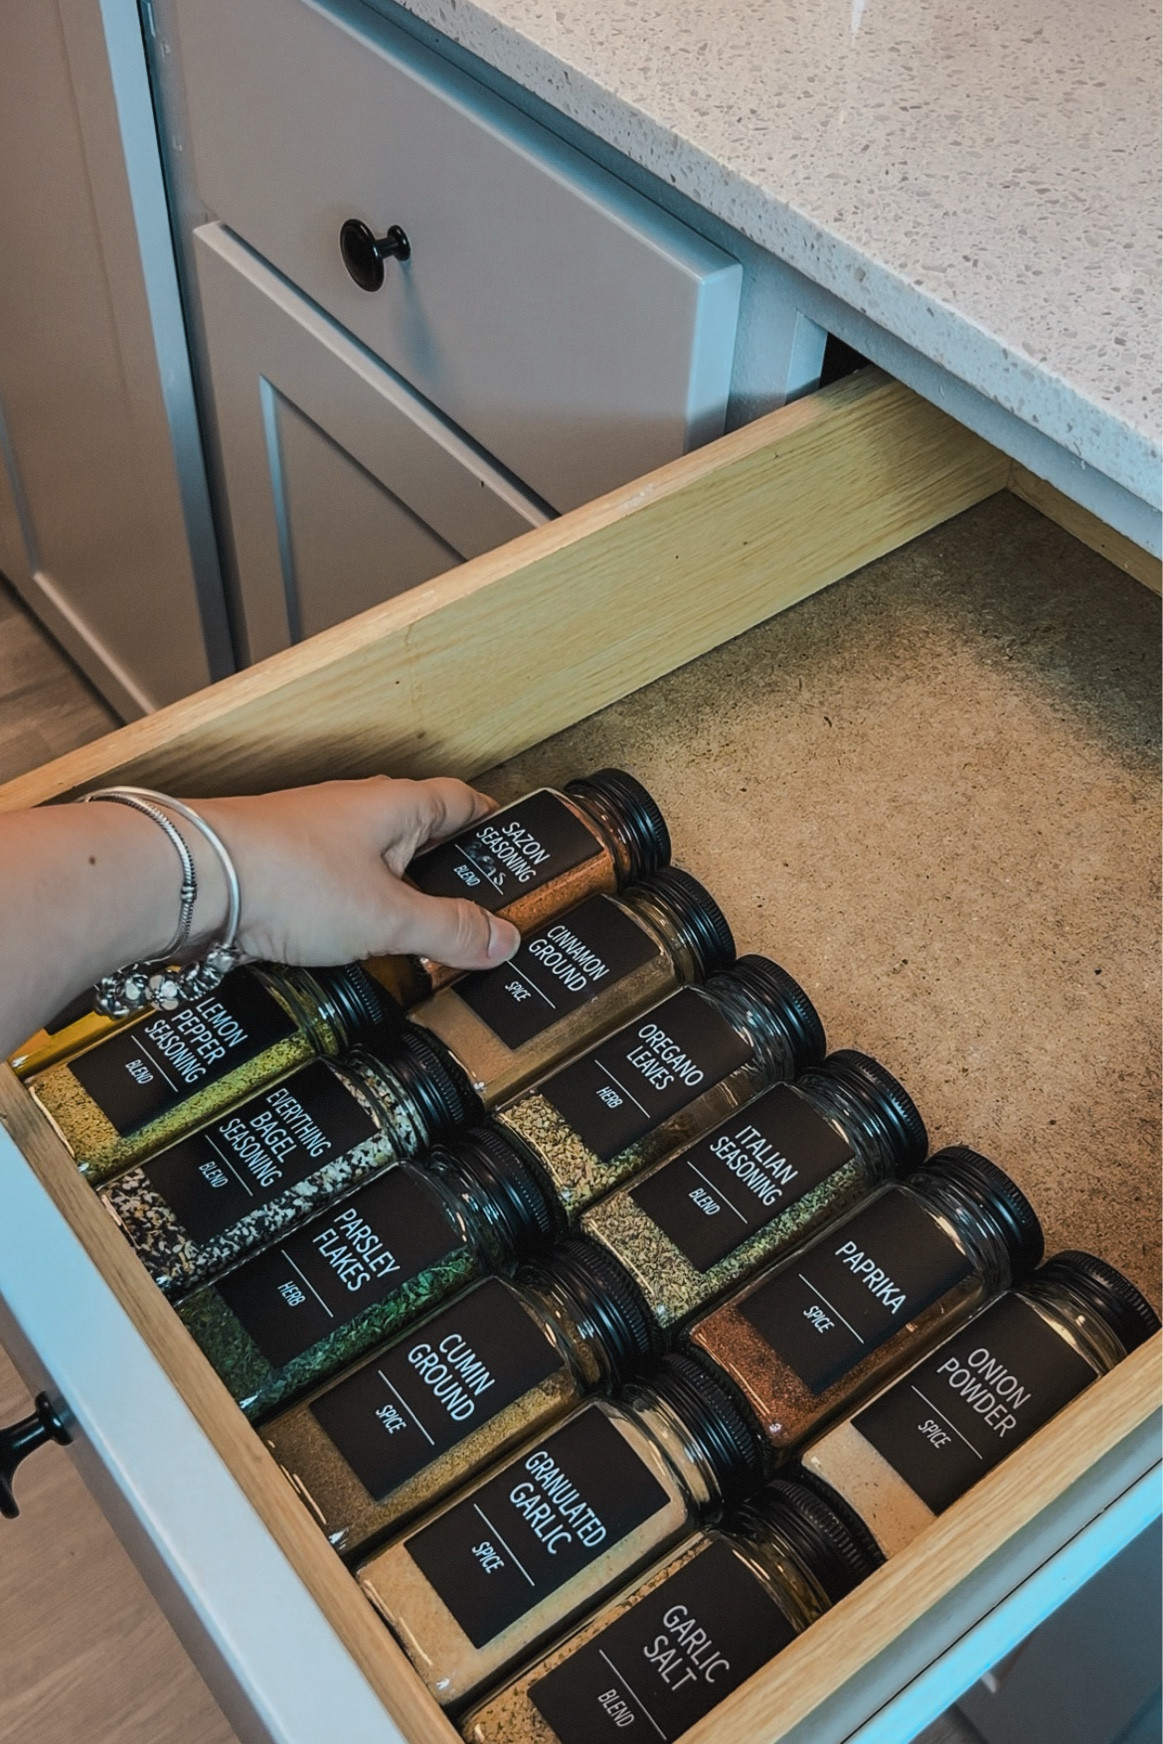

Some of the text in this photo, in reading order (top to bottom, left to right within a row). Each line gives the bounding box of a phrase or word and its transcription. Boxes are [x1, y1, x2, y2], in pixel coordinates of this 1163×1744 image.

[474, 826, 535, 884] SEASONING
[502, 821, 550, 866] SAZON
[453, 863, 481, 887] BLEND
[528, 938, 587, 992] GROUND
[547, 924, 609, 982] CINNAMON
[503, 980, 532, 1002] SPICE
[170, 1011, 225, 1065] PEPPER
[195, 995, 249, 1047] LEMON
[125, 1060, 154, 1084] BLEND
[144, 1019, 206, 1083] SEASONING
[625, 1044, 674, 1091] LEAVES
[637, 1023, 704, 1087] OREGANO
[265, 1088, 332, 1157] EVERYTHING
[596, 1086, 623, 1108] HERB
[219, 1118, 282, 1187] SEASONING
[249, 1112, 298, 1163] BAGEL
[736, 1125, 799, 1185] ITALIAN
[198, 1161, 229, 1188] BLEND
[709, 1136, 782, 1207] SEASONING
[688, 1187, 721, 1216] BLEND
[312, 1228, 370, 1292] FLAKES
[334, 1208, 400, 1279] PARSLEY
[277, 1281, 306, 1307] HERB
[835, 1240, 907, 1315] PAPRIKA
[803, 1304, 834, 1334] SPICE
[407, 1344, 475, 1421] GROUND
[439, 1334, 495, 1396] CUMIN
[967, 1348, 1031, 1410] ONION
[375, 1404, 407, 1434] SPICE
[937, 1357, 1017, 1438] POWDER
[918, 1418, 951, 1449] SPICE
[509, 1482, 571, 1555] GARLIC
[525, 1450, 607, 1548] GRANULATED
[472, 1541, 504, 1574] SPICE
[644, 1636, 697, 1692] SALT
[662, 1604, 730, 1683] GARLIC
[598, 1689, 636, 1728] BLEND
